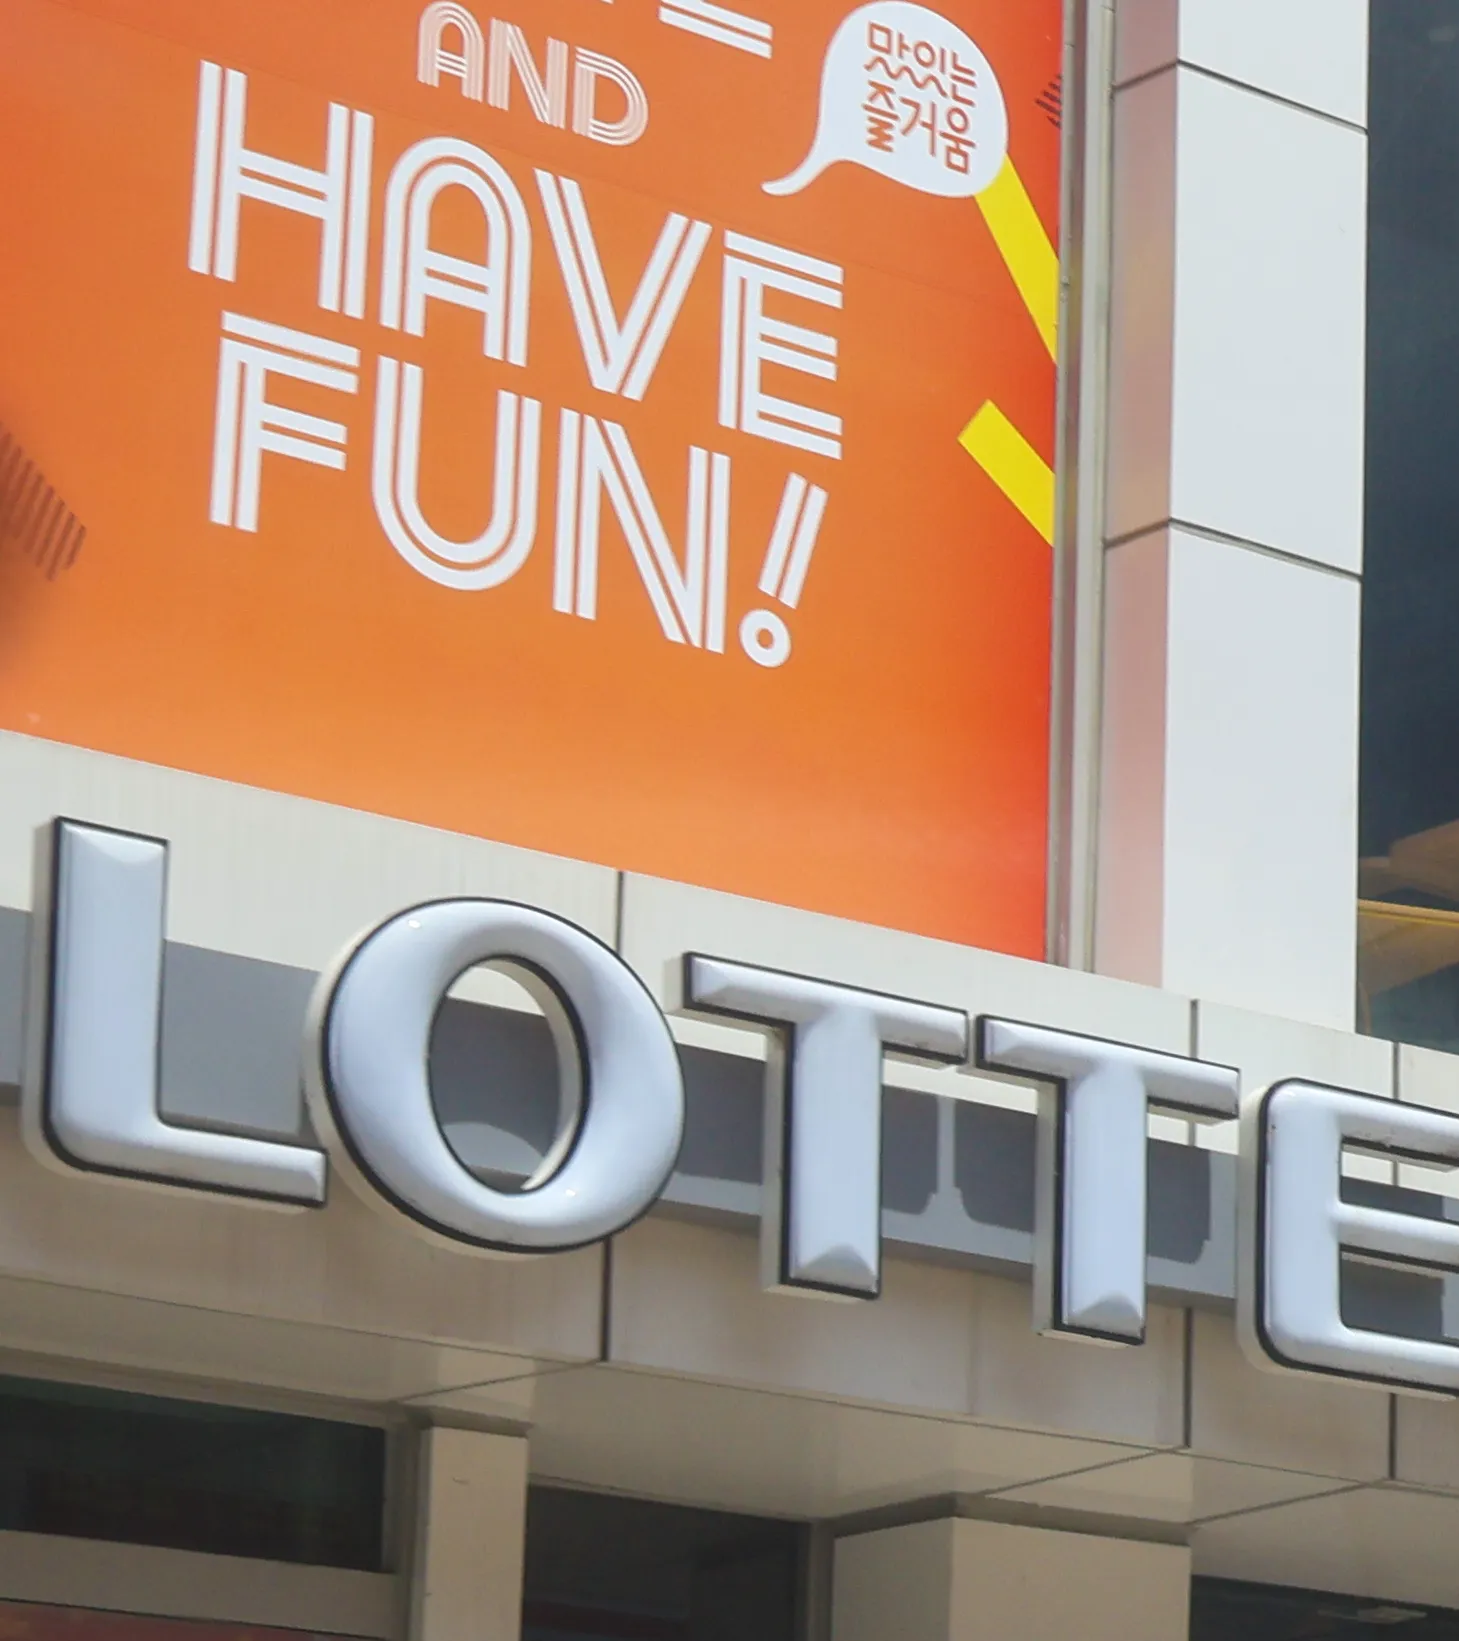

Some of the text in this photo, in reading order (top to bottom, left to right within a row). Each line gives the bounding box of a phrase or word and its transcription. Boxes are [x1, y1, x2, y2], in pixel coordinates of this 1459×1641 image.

[416, 0, 649, 146] AND
[861, 78, 977, 175] 즐거움
[863, 20, 977, 108] 맛있는
[188, 59, 844, 461] HAVE
[209, 310, 829, 668] FUN!
